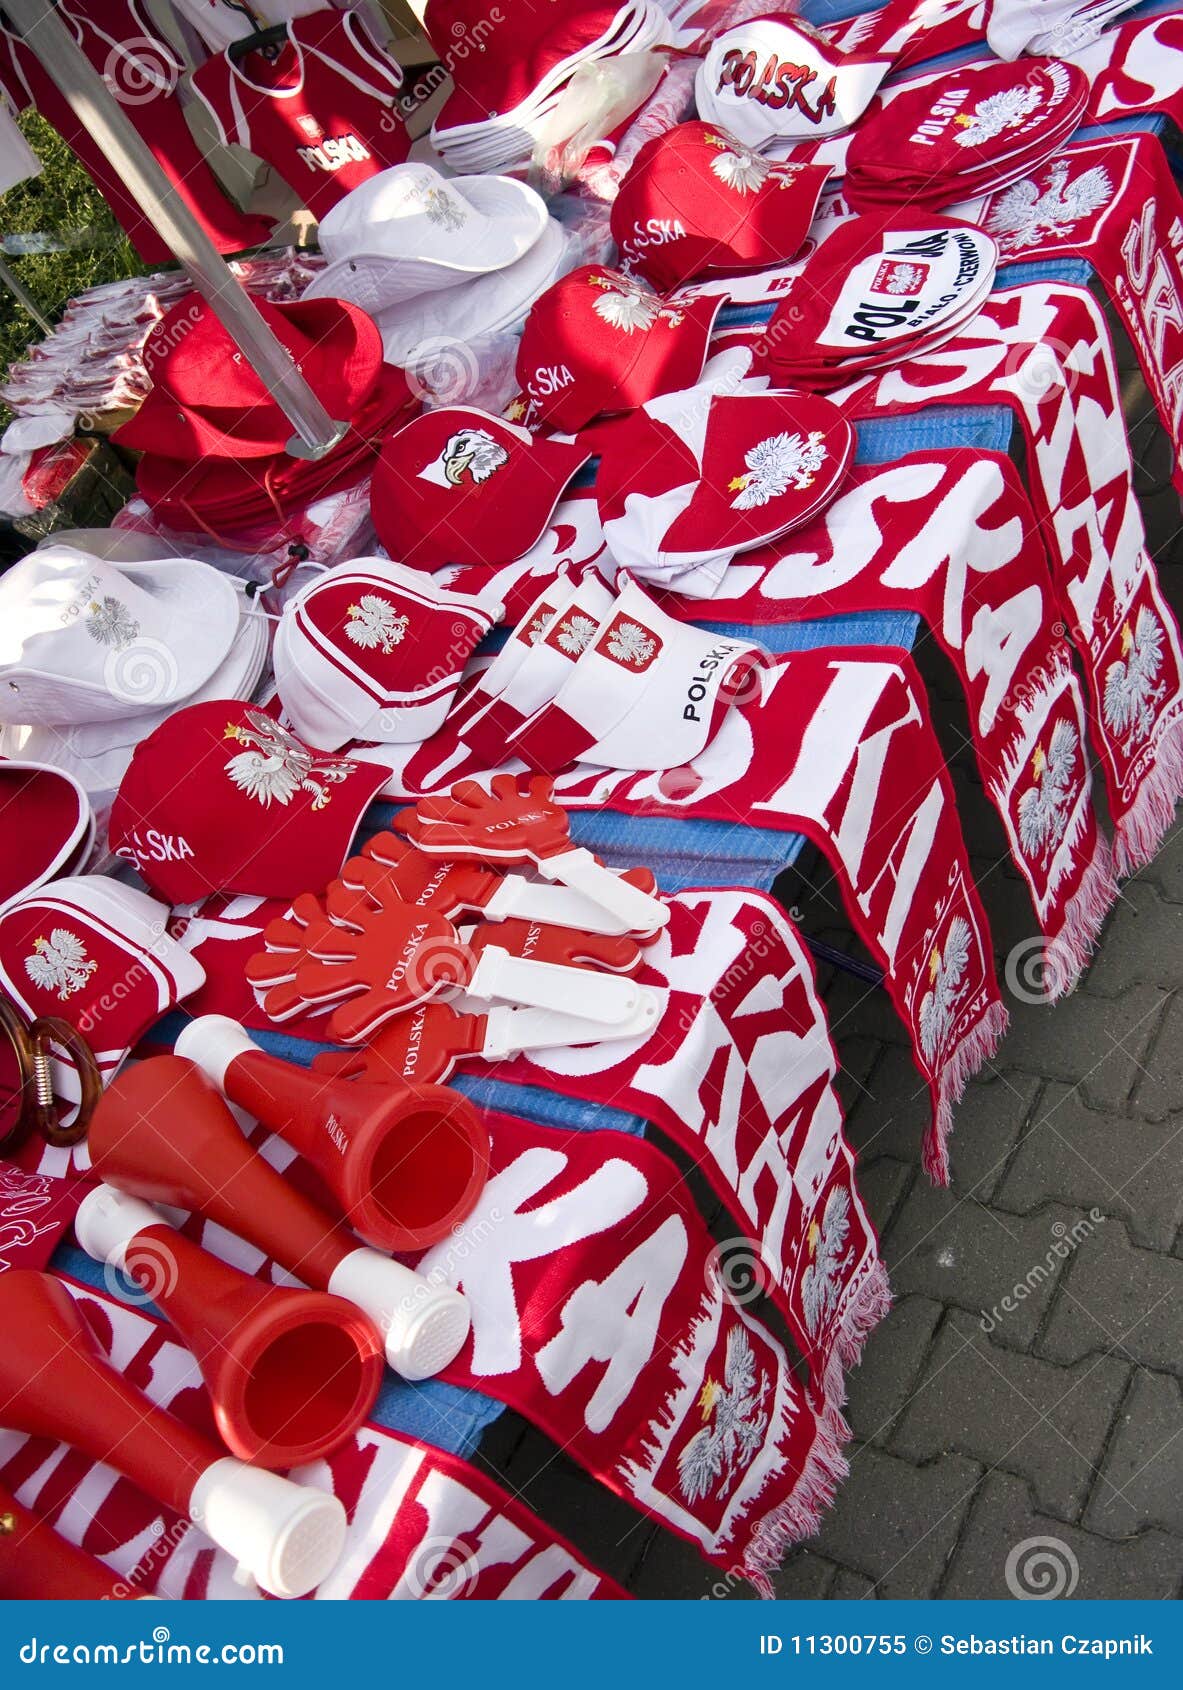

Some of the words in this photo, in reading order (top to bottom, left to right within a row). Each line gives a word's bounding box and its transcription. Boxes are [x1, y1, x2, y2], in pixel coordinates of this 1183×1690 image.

[715, 48, 838, 124] POLSKA
[909, 89, 970, 146] POLSKA
[296, 132, 371, 173] POLSKA
[60, 575, 103, 625] POLSKA
[683, 645, 740, 722] POLSKA
[484, 810, 554, 833] POLSKA
[385, 922, 430, 992] POLSKA
[403, 1006, 426, 1076] POLSKA
[325, 1113, 349, 1155] POLSKA
